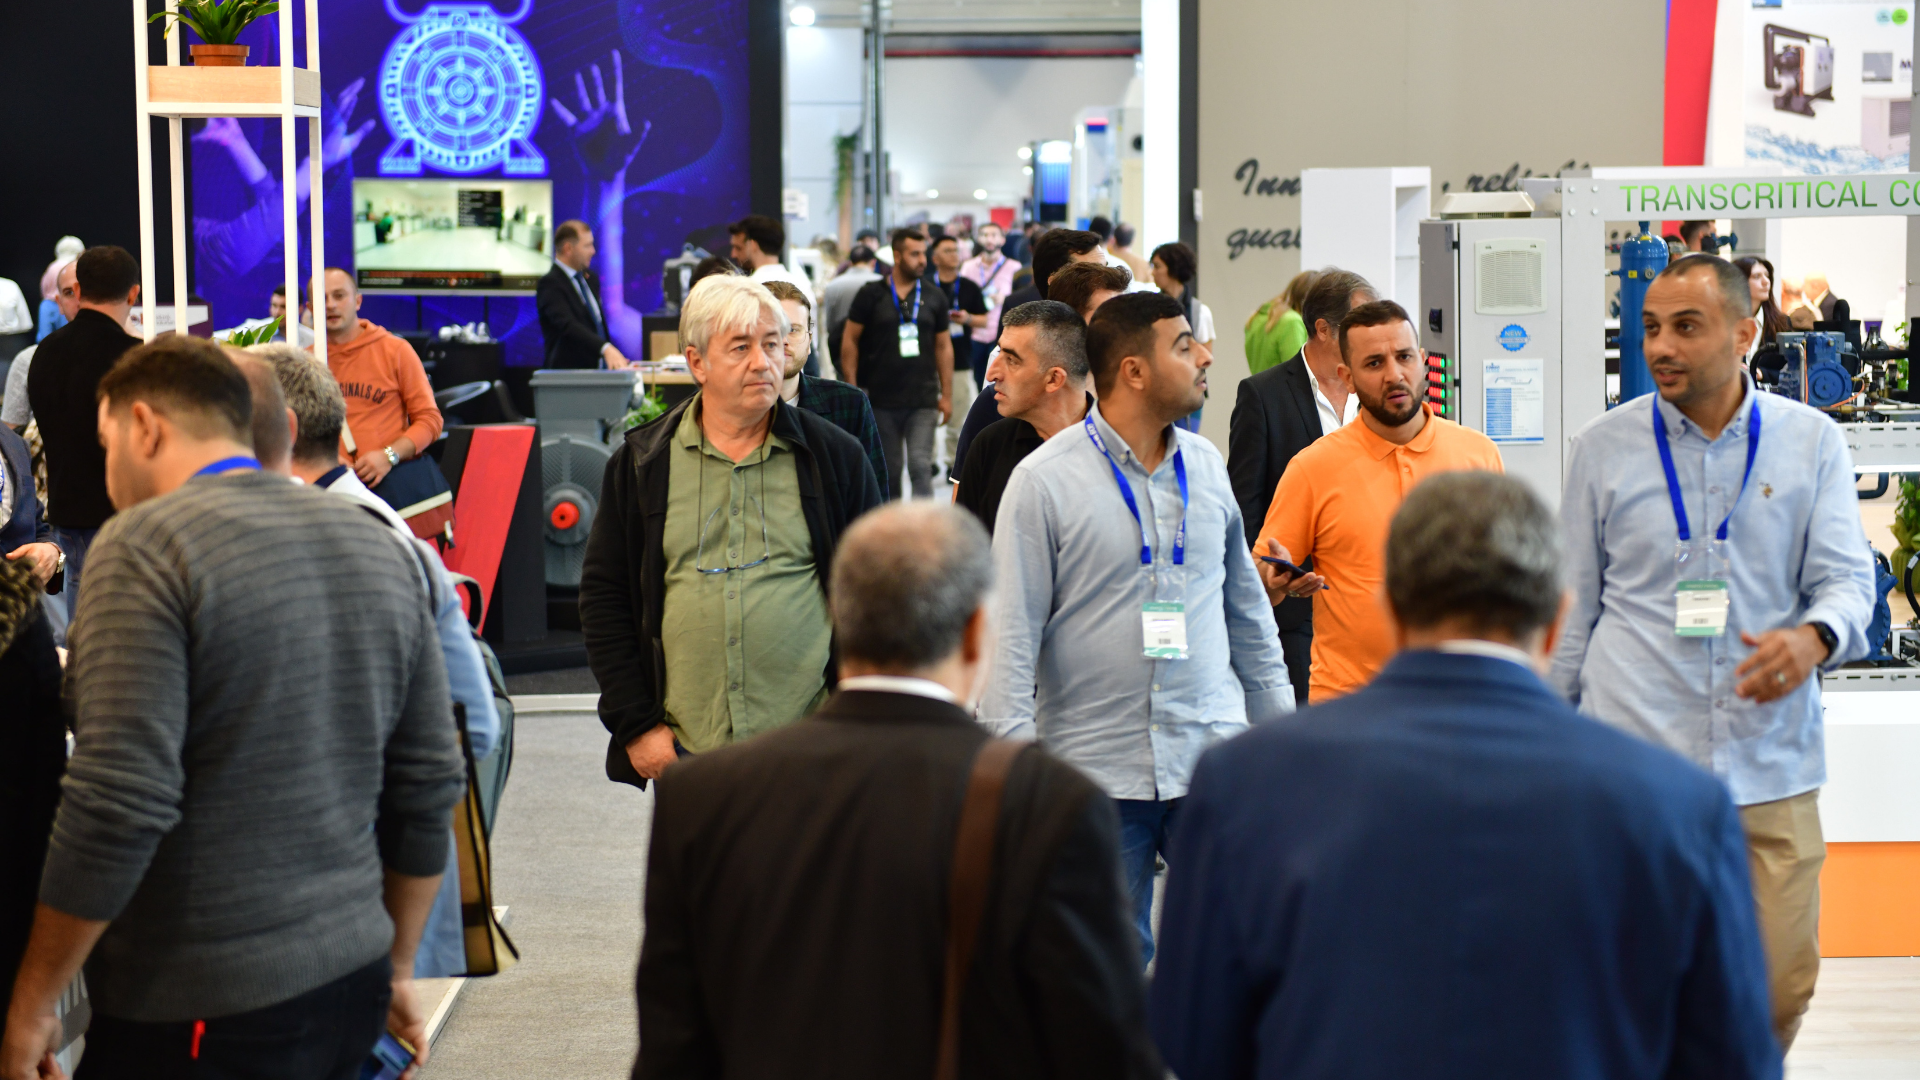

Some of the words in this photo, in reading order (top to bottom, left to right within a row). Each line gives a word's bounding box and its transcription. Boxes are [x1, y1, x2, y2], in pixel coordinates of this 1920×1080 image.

[1235, 158, 1301, 196] Inn
[1619, 181, 1878, 213] TRANSCRITICAL
[1889, 179, 1920, 208] C
